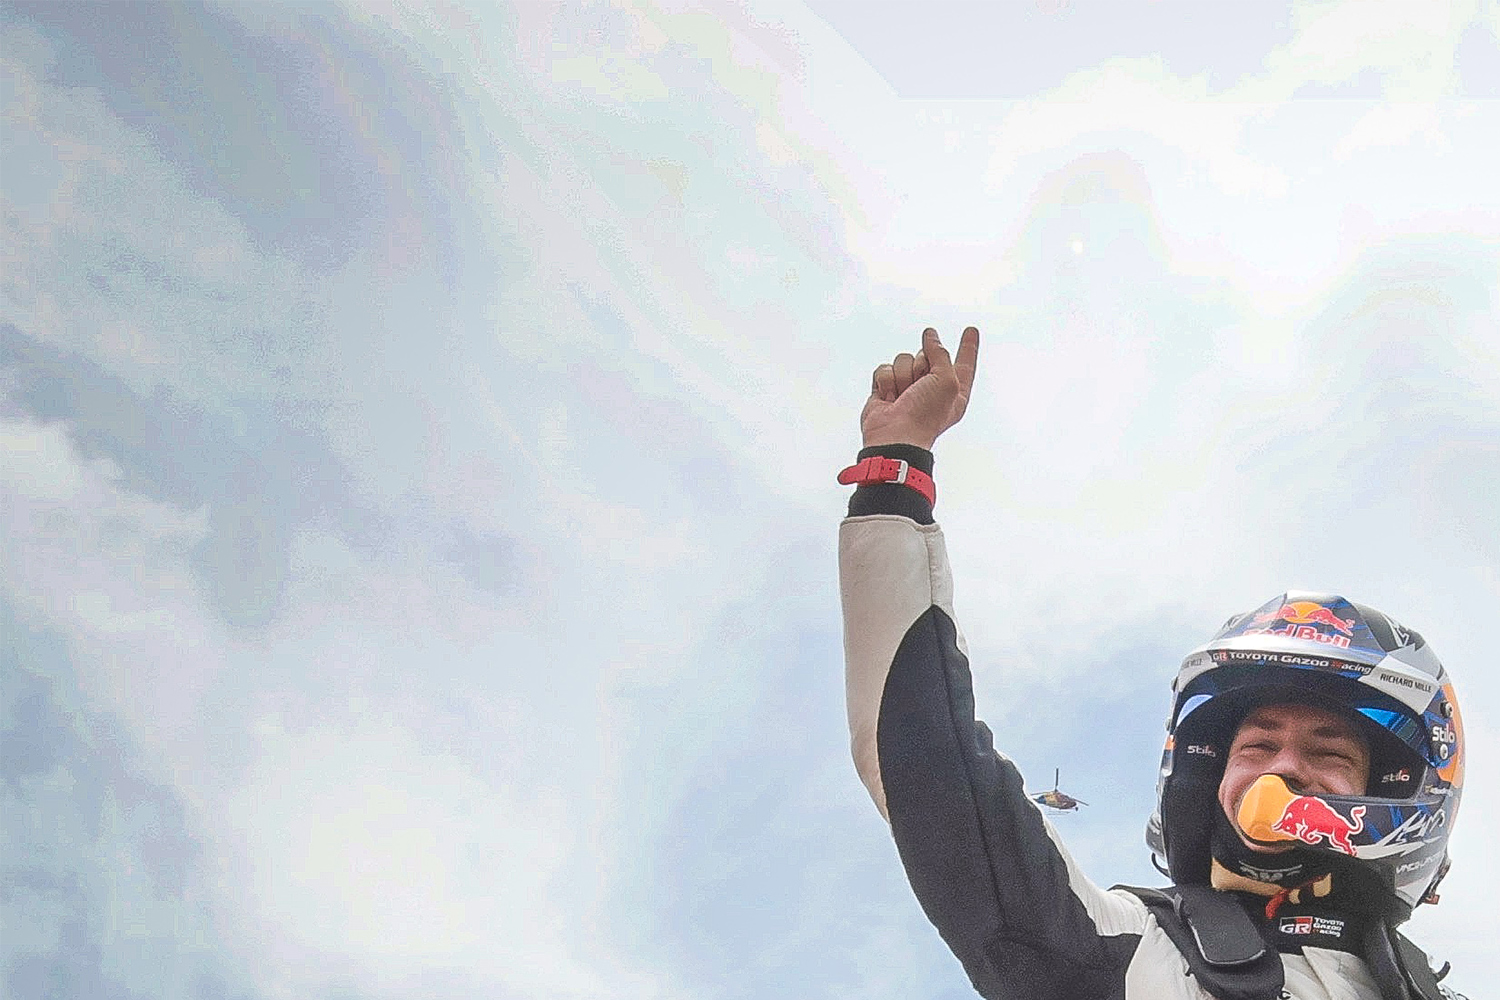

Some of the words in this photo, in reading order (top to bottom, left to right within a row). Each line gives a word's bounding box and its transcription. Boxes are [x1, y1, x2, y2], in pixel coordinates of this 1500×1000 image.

[1229, 651, 1278, 662] TOYOTA
[1280, 655, 1329, 667] GAZOO
[1380, 673, 1414, 688] RICHARD
[1314, 917, 1344, 927] TOYOTA
[1280, 923, 1311, 935] GR
